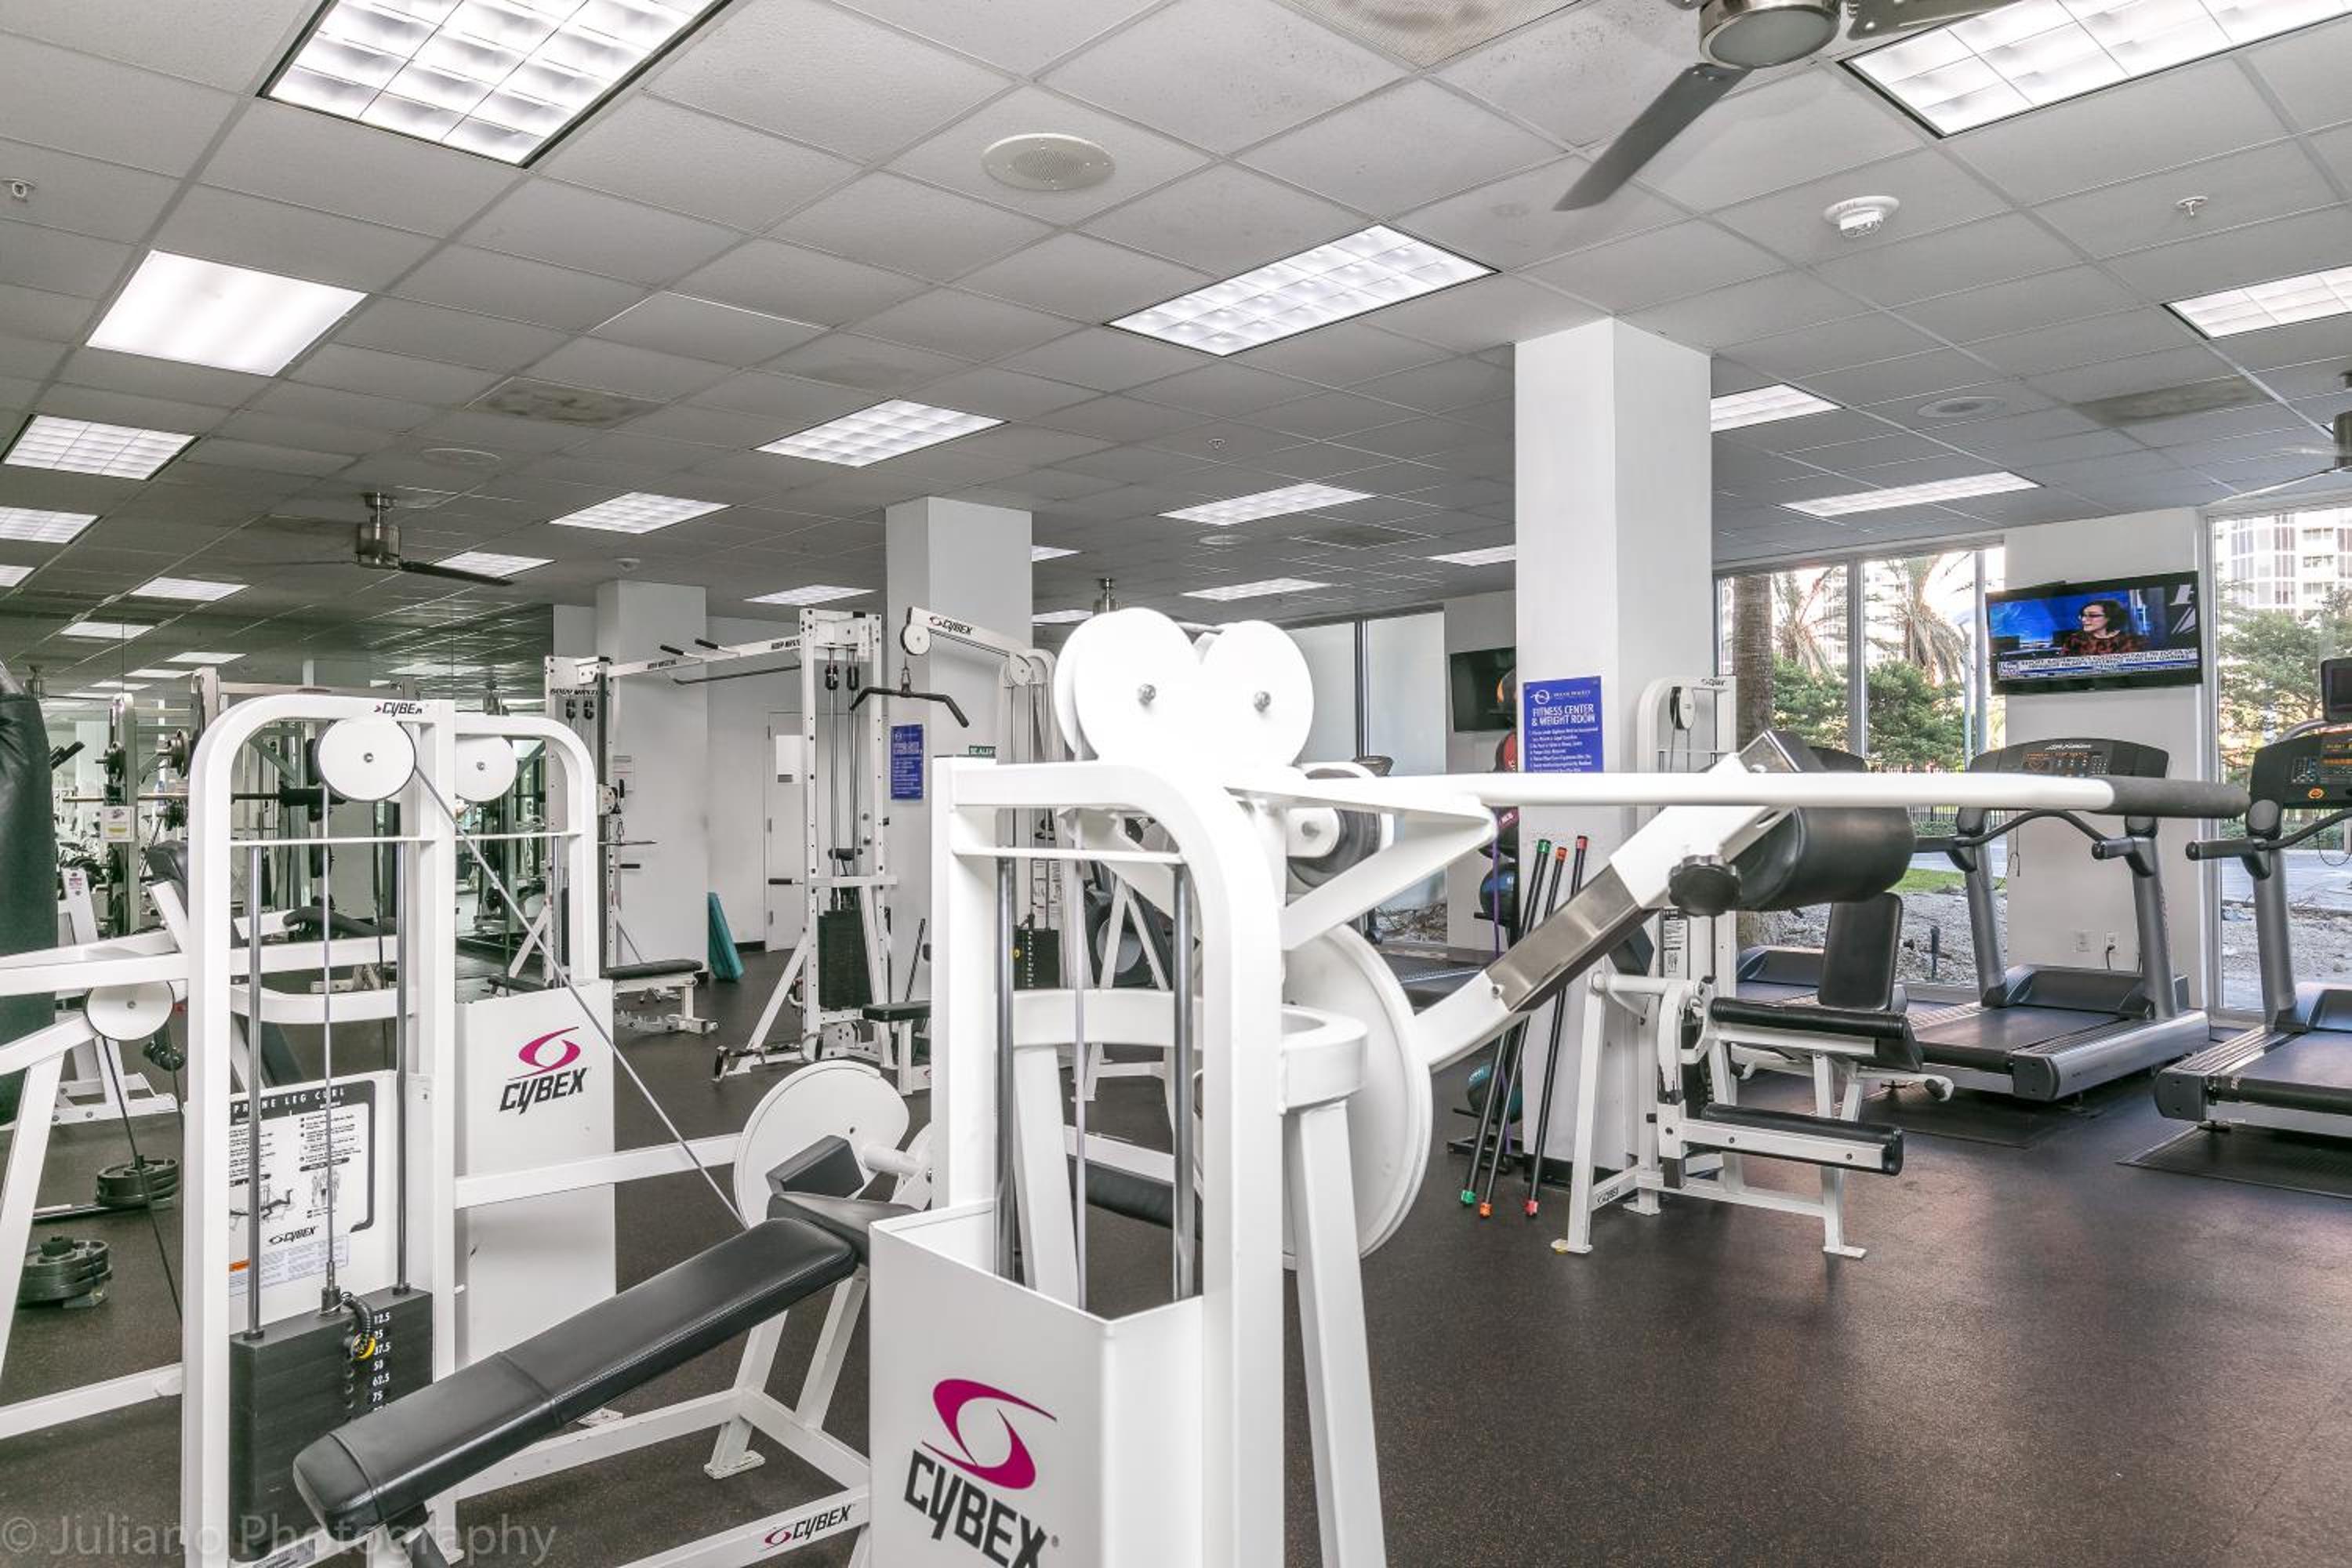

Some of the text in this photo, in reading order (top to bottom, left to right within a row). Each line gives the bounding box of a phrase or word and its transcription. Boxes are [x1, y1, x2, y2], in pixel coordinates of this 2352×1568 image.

[942, 619, 973, 636] CYBEX
[1532, 703, 1594, 717] FITNESS CENTER
[1531, 714, 1595, 727] & WEIGHT ROOM
[499, 1067, 587, 1115] CYBEX
[234, 1098, 276, 1114] PRNE
[285, 1094, 307, 1105] LEG
[373, 1312, 390, 1324] 12.5
[373, 1341, 391, 1356] 37.5
[373, 1359, 384, 1371] 50
[372, 1373, 390, 1387] 62.5
[372, 1390, 383, 1403] 75
[904, 1449, 1047, 1568] CYBEX
[792, 1504, 851, 1541] CYBEX
